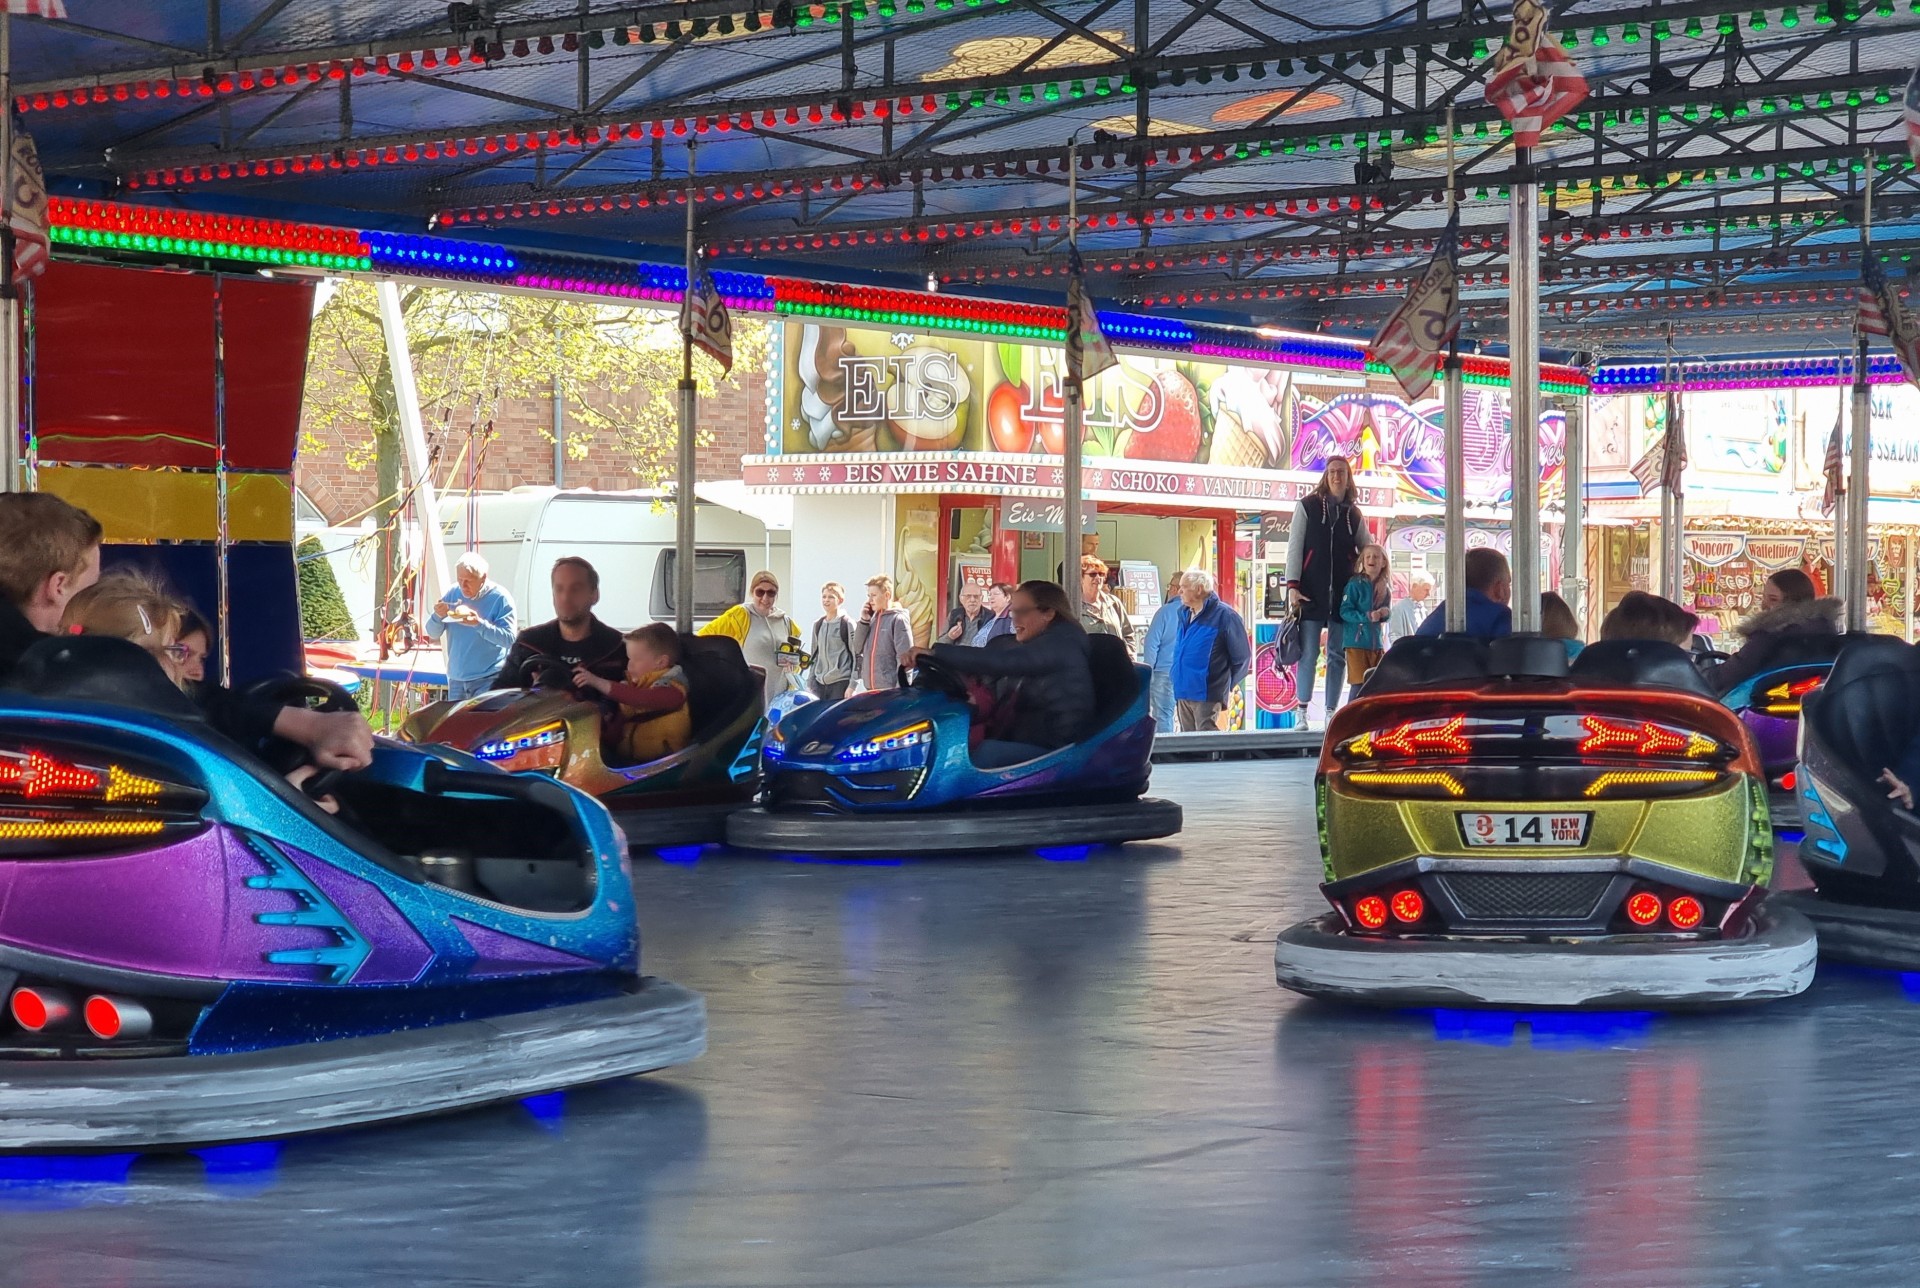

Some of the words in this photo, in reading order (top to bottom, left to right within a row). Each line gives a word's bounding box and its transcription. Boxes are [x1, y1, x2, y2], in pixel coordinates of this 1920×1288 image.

[838, 352, 959, 421] EIS
[844, 463, 883, 483] EIS
[888, 462, 941, 482] WIE
[945, 462, 1037, 485] SAHNE
[1110, 470, 1179, 493] SCHOKO
[1202, 477, 1272, 500] VANILLE
[1008, 502, 1088, 526] Eis-Mr
[1691, 540, 1734, 558] Popcorn
[1748, 543, 1799, 560] Waffeltüten
[1505, 816, 1544, 843] 14
[1551, 818, 1580, 829] NEW
[1551, 829, 1580, 841] YORK
